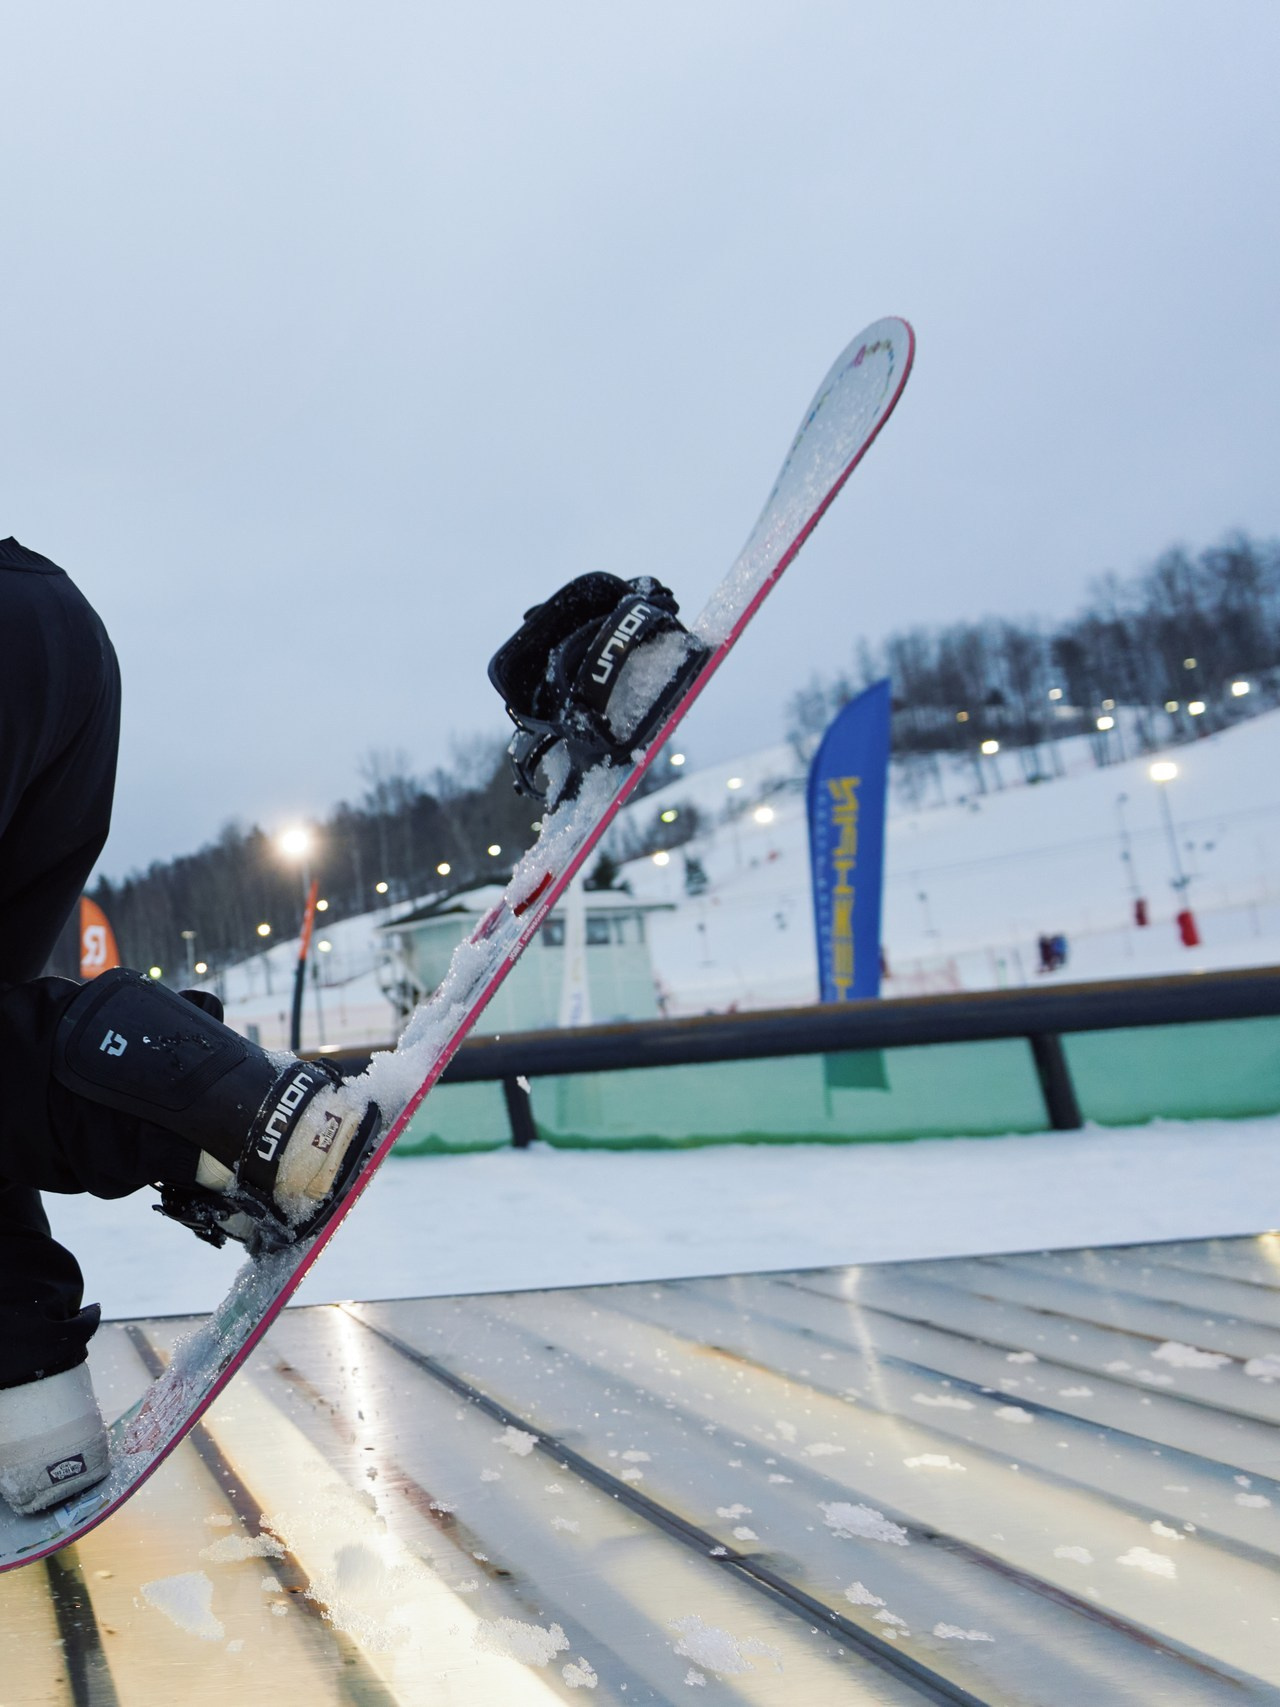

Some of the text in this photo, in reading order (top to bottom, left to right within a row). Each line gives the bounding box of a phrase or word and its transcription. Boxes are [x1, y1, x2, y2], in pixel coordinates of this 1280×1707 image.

[592, 604, 651, 684] UNION
[509, 942, 525, 962] JOINT
[257, 1072, 313, 1161] UNION
